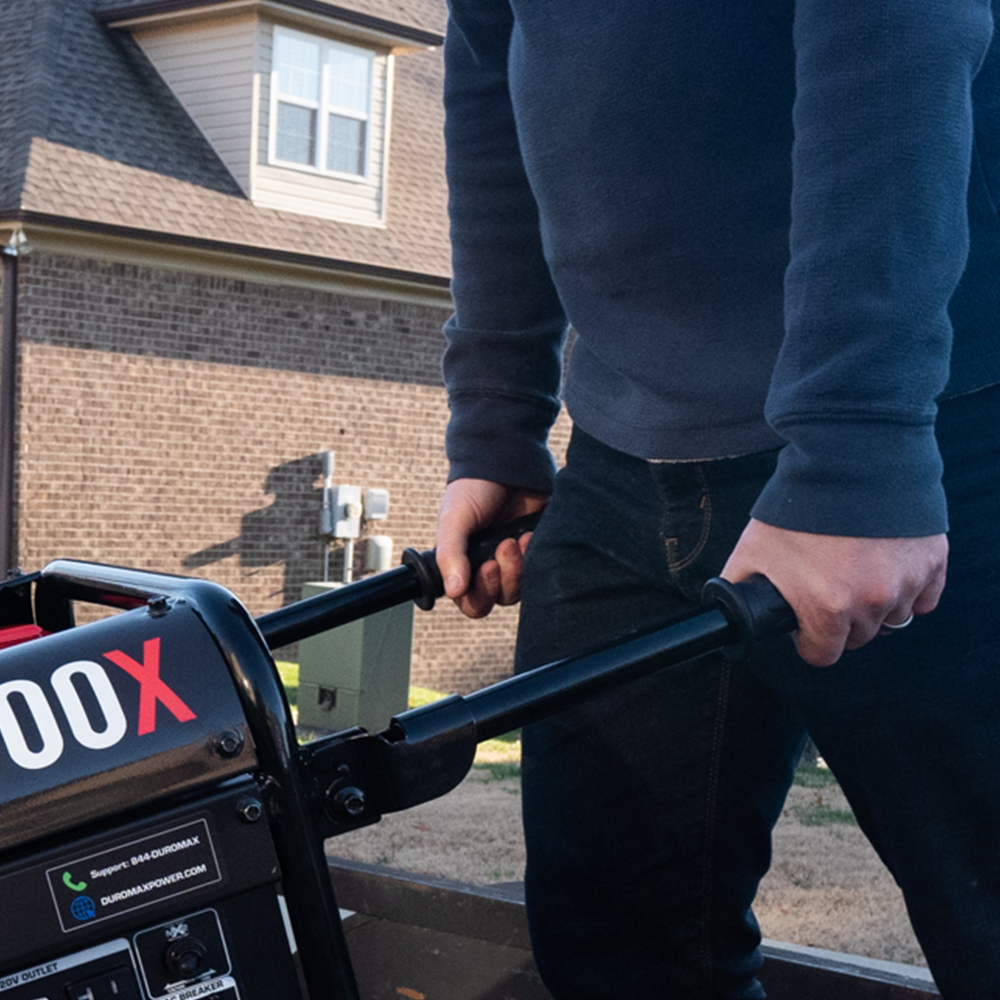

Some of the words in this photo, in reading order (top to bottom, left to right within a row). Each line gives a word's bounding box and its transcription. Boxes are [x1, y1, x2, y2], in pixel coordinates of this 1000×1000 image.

[90, 859, 130, 881] Support:
[100, 864, 207, 906] DUROMAXPOWER.COM
[21, 962, 58, 981] OUTLET
[178, 980, 223, 1000] BREAKER
